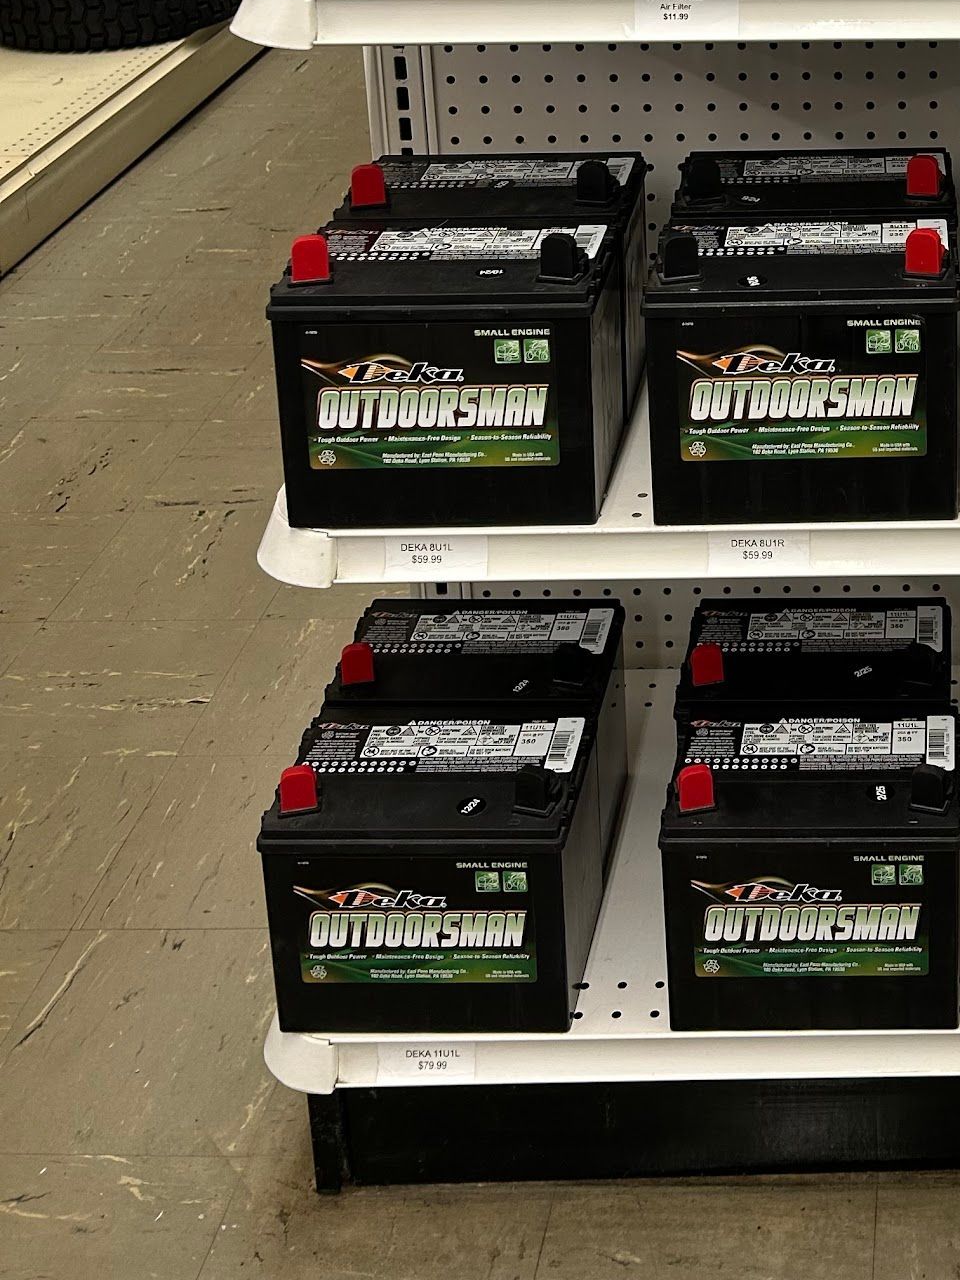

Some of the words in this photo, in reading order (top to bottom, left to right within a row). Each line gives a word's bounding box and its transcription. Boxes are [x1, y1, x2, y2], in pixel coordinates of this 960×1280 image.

[720, 353, 835, 374] Deka
[347, 362, 464, 384] Deka
[690, 375, 918, 420] OUTDOORSMAN
[318, 385, 549, 429] OUTDOORSMAN
[400, 543, 427, 552] DEKA
[428, 543, 453, 552] 8U1L
[731, 539, 758, 548] DEKA
[760, 539, 785, 548] 8U1R
[412, 554, 442, 565] $59.99
[742, 550, 773, 560] $59.99
[876, 786, 887, 801] 2/25
[460, 798, 481, 814] 12/24
[336, 890, 446, 909] Deka
[730, 884, 842, 902] Deka
[309, 911, 527, 948] OUTDOORSMAN
[705, 904, 921, 941] OUTDOORSMAN
[406, 1050, 432, 1058] DEKA
[434, 1050, 460, 1058] 11U1L
[418, 1061, 447, 1070] $79.99
